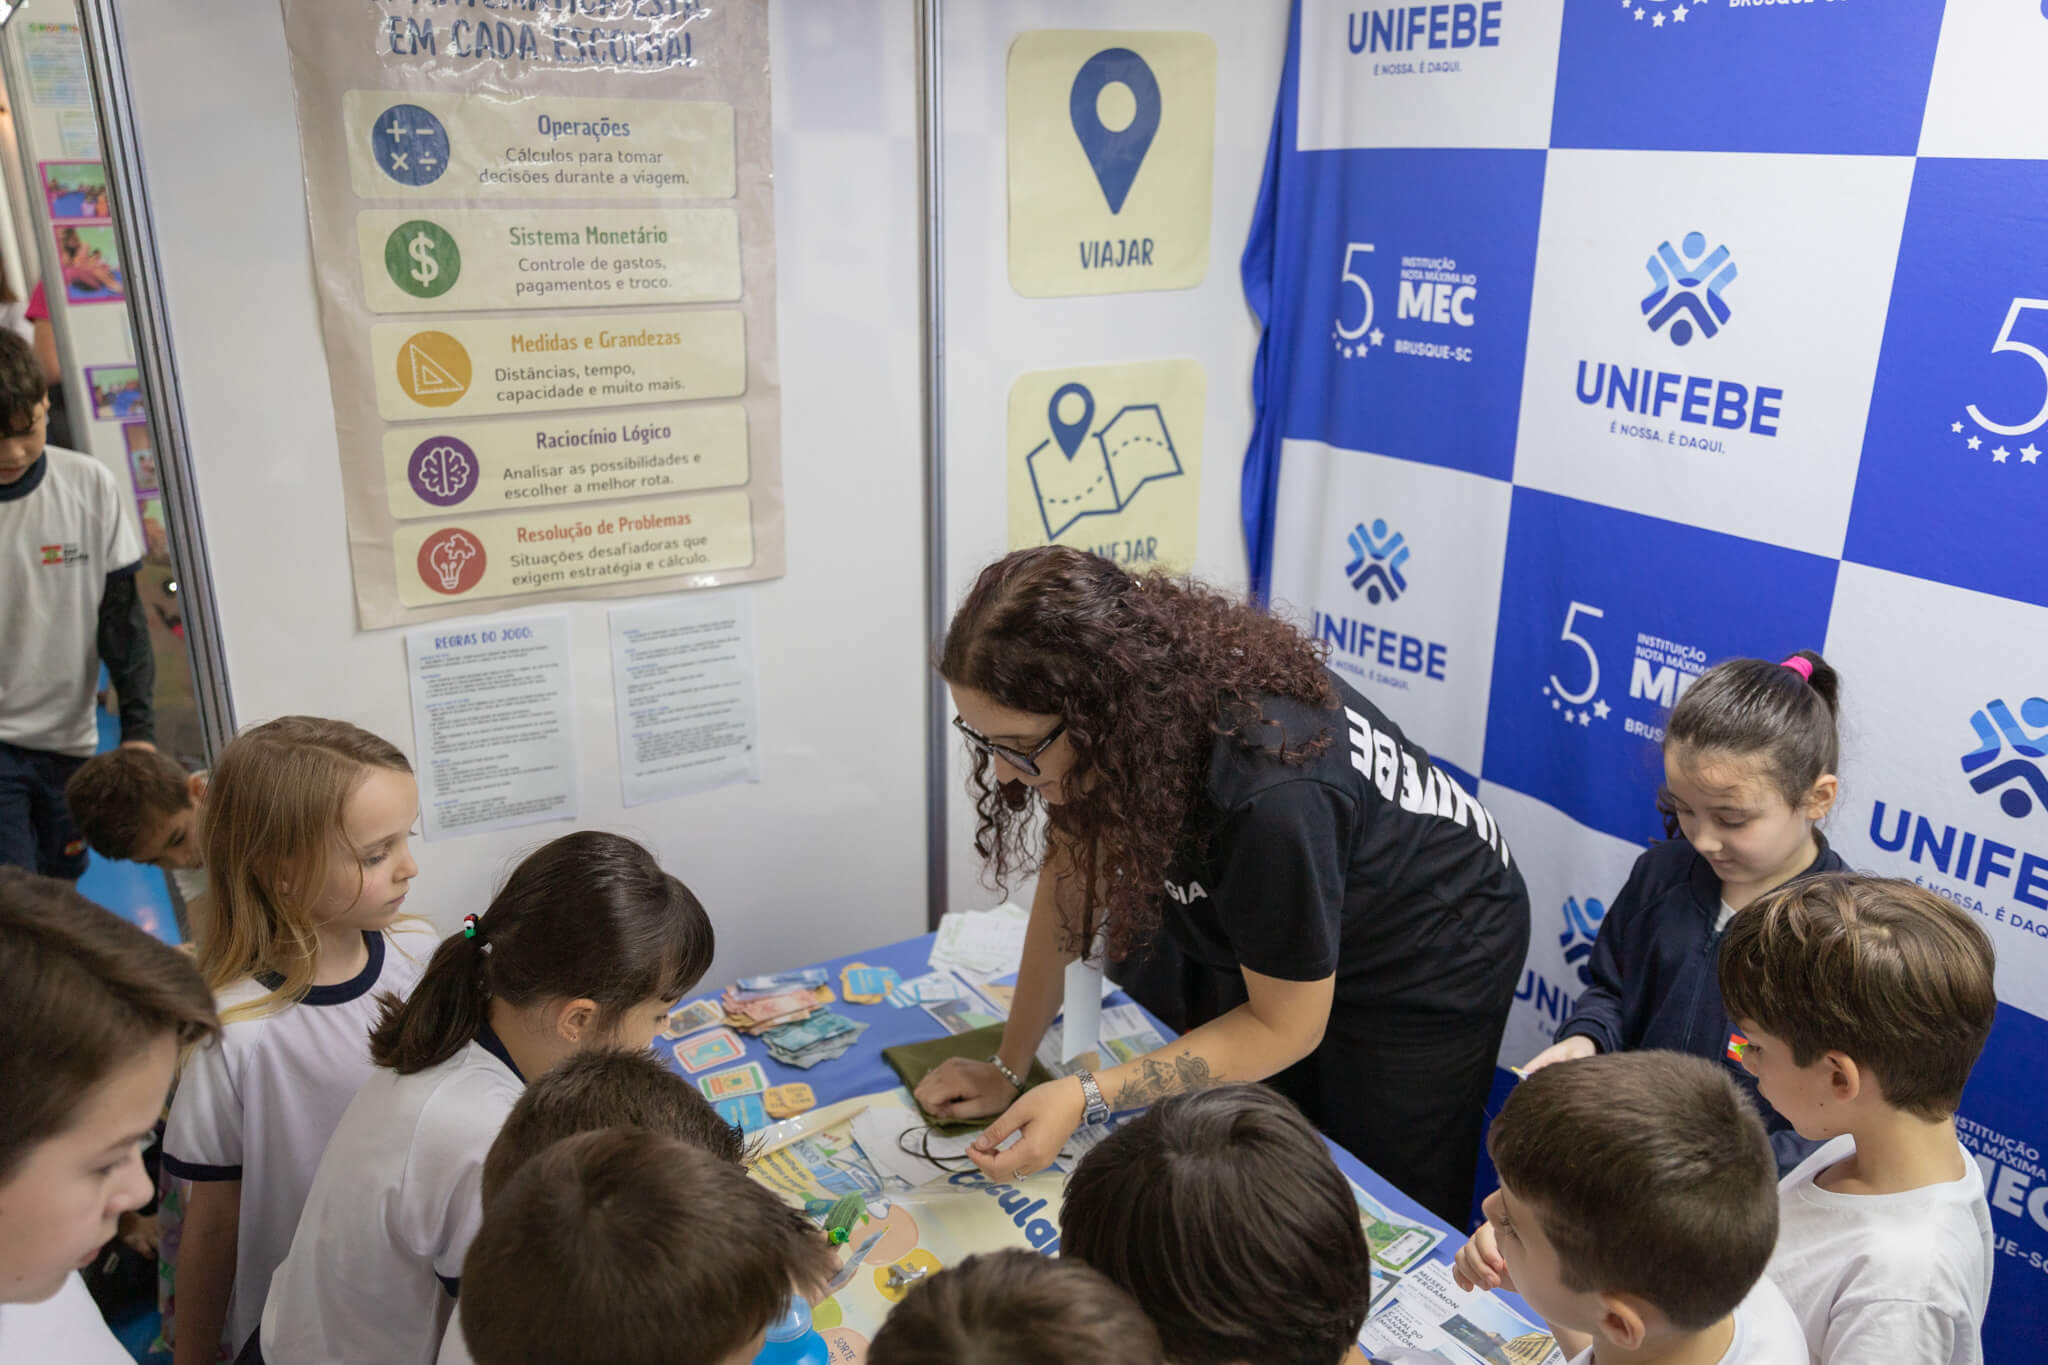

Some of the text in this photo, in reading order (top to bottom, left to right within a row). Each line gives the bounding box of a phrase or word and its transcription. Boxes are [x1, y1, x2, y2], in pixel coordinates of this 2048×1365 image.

[389, 16, 436, 56] EM
[452, 19, 539, 60] CADA
[1348, 1, 1502, 55] UNIFEBE
[537, 114, 631, 142] Operações
[505, 147, 664, 166] Cálculos para tomar
[479, 168, 690, 188] decisões durante a viagem.
[509, 225, 668, 246] Sistema Monetário
[518, 256, 667, 274] Controle de gastos,
[1080, 238, 1154, 269] VIAJAR
[1401, 256, 1456, 271] INSTITUIÇÃO
[515, 277, 673, 297] pagamentos e troco.
[1401, 269, 1423, 280] NOTA
[1335, 242, 1375, 340] 5
[1397, 281, 1477, 327] MEC
[511, 328, 681, 353] Medidas e Grandezas
[1395, 339, 1473, 362] BRUSQUE-SC
[495, 363, 636, 382] Distâncias, tempo,
[1965, 297, 2048, 436] 5
[496, 376, 686, 405] capacidade e muito mais.
[1576, 360, 1783, 437] UNIFEBE
[536, 423, 672, 449] Raciocínio Lógico
[1610, 420, 1725, 455] É NOSSA. É DAQUI.
[503, 453, 702, 480] Analisar as possibilidades e
[505, 474, 674, 500] escolher a melhor rota.
[518, 512, 692, 543] Resolução de Problemas
[510, 535, 709, 568] Situações desafiadoras que
[511, 551, 710, 588] exigem estratégia e cálculo.
[434, 632, 478, 650] REGRAS
[481, 631, 497, 645] DO
[1550, 600, 1604, 704] 5
[1637, 632, 1706, 662] INSTITUIÇÃO
[1635, 645, 1665, 664] NOTA
[1995, 906, 2006, 922] É
[1412, 1274, 1460, 1309] PERGAMON
